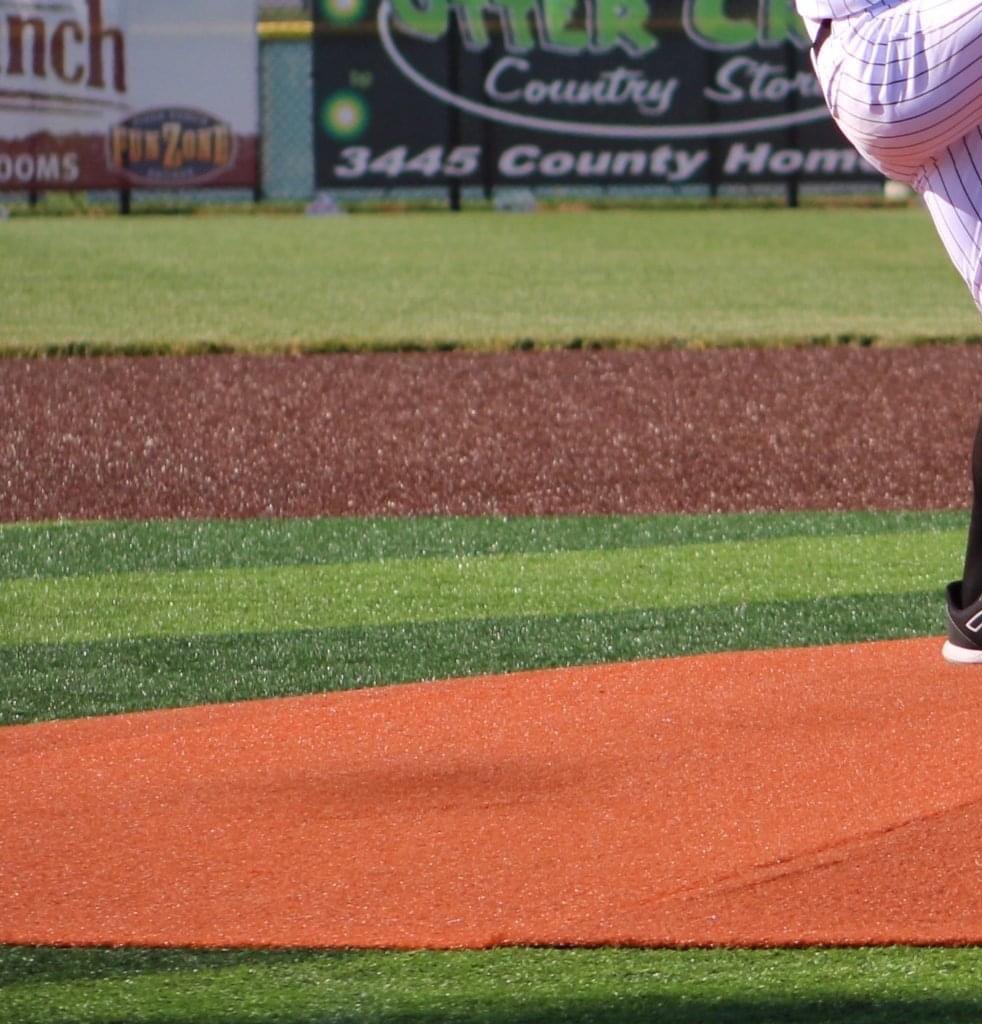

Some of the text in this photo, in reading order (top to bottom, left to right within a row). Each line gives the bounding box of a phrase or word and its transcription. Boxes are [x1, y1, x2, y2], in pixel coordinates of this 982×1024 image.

[485, 56, 678, 115] Country
[333, 144, 482, 179] 3445
[498, 143, 707, 181] County
